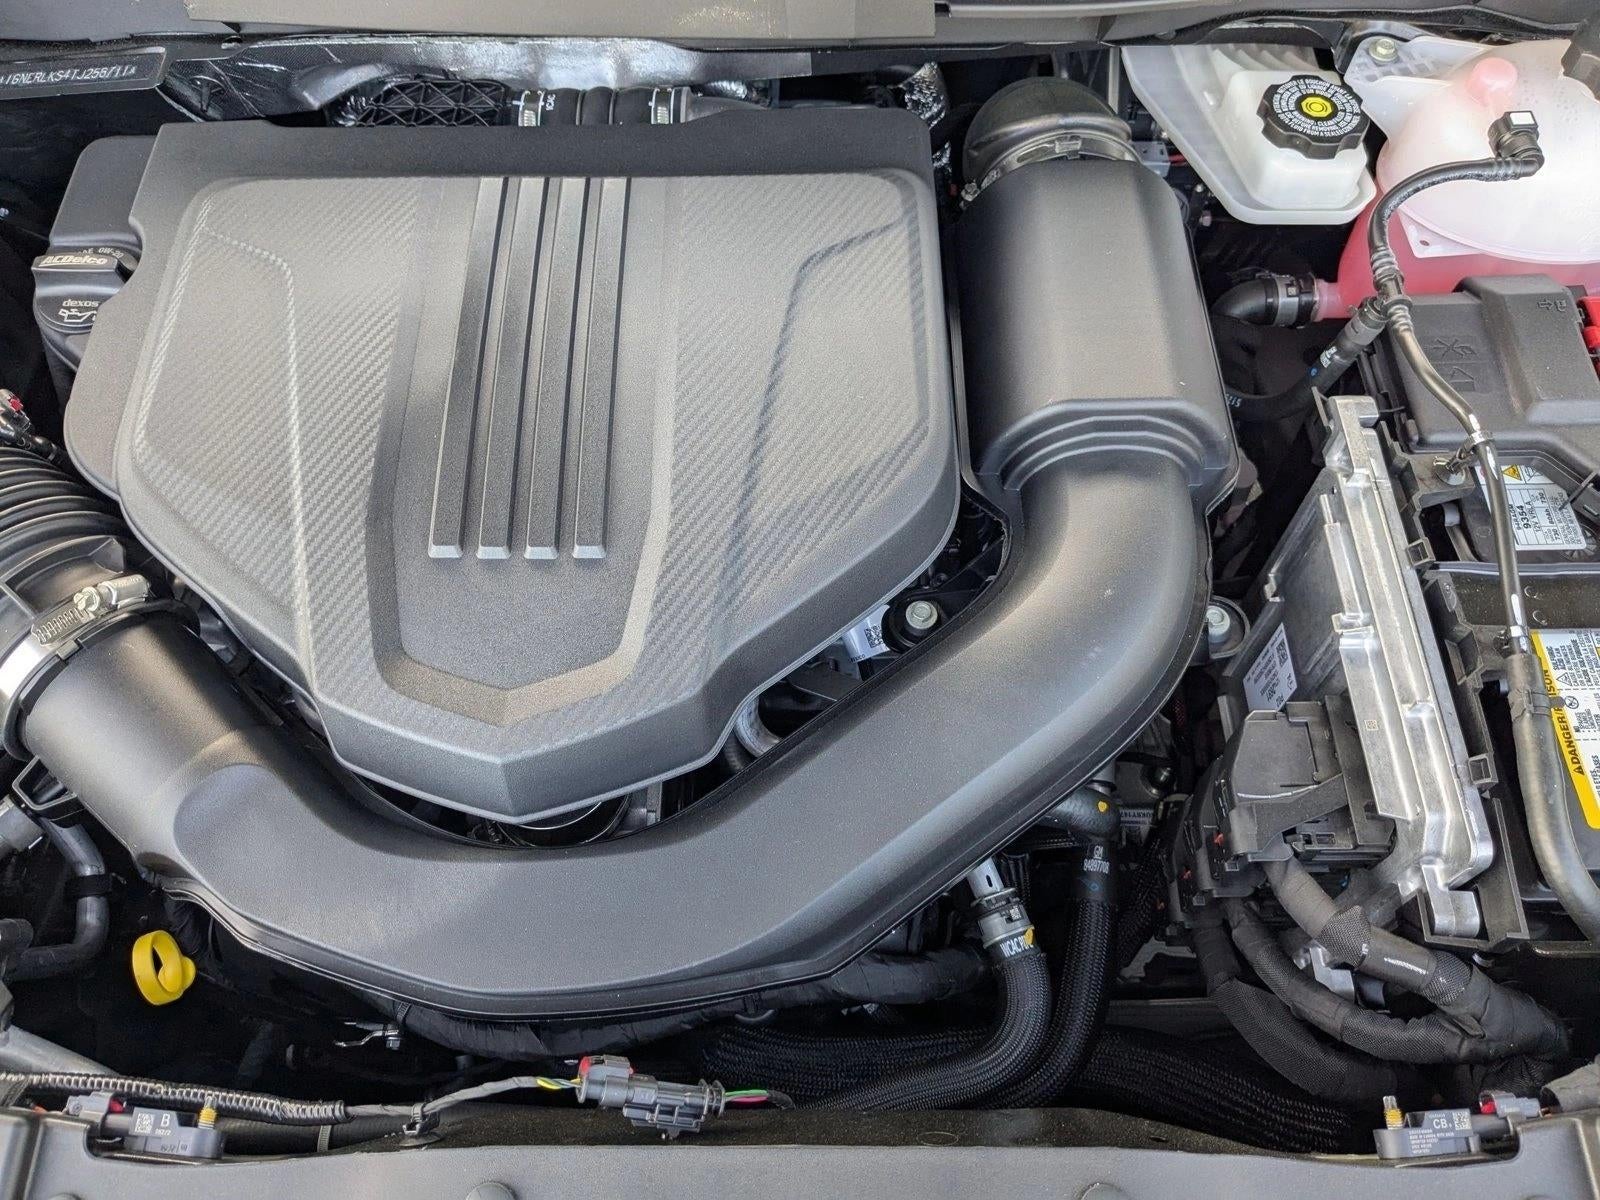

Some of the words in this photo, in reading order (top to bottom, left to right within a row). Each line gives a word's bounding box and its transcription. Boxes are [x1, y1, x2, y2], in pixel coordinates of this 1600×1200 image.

[98, 247, 124, 259] 0W-20
[41, 255, 108, 266] ACDelco
[62, 299, 99, 308] dexos
[1516, 505, 1531, 529] 9354
[160, 1112, 171, 1128] B
[1433, 1118, 1448, 1129] CB
